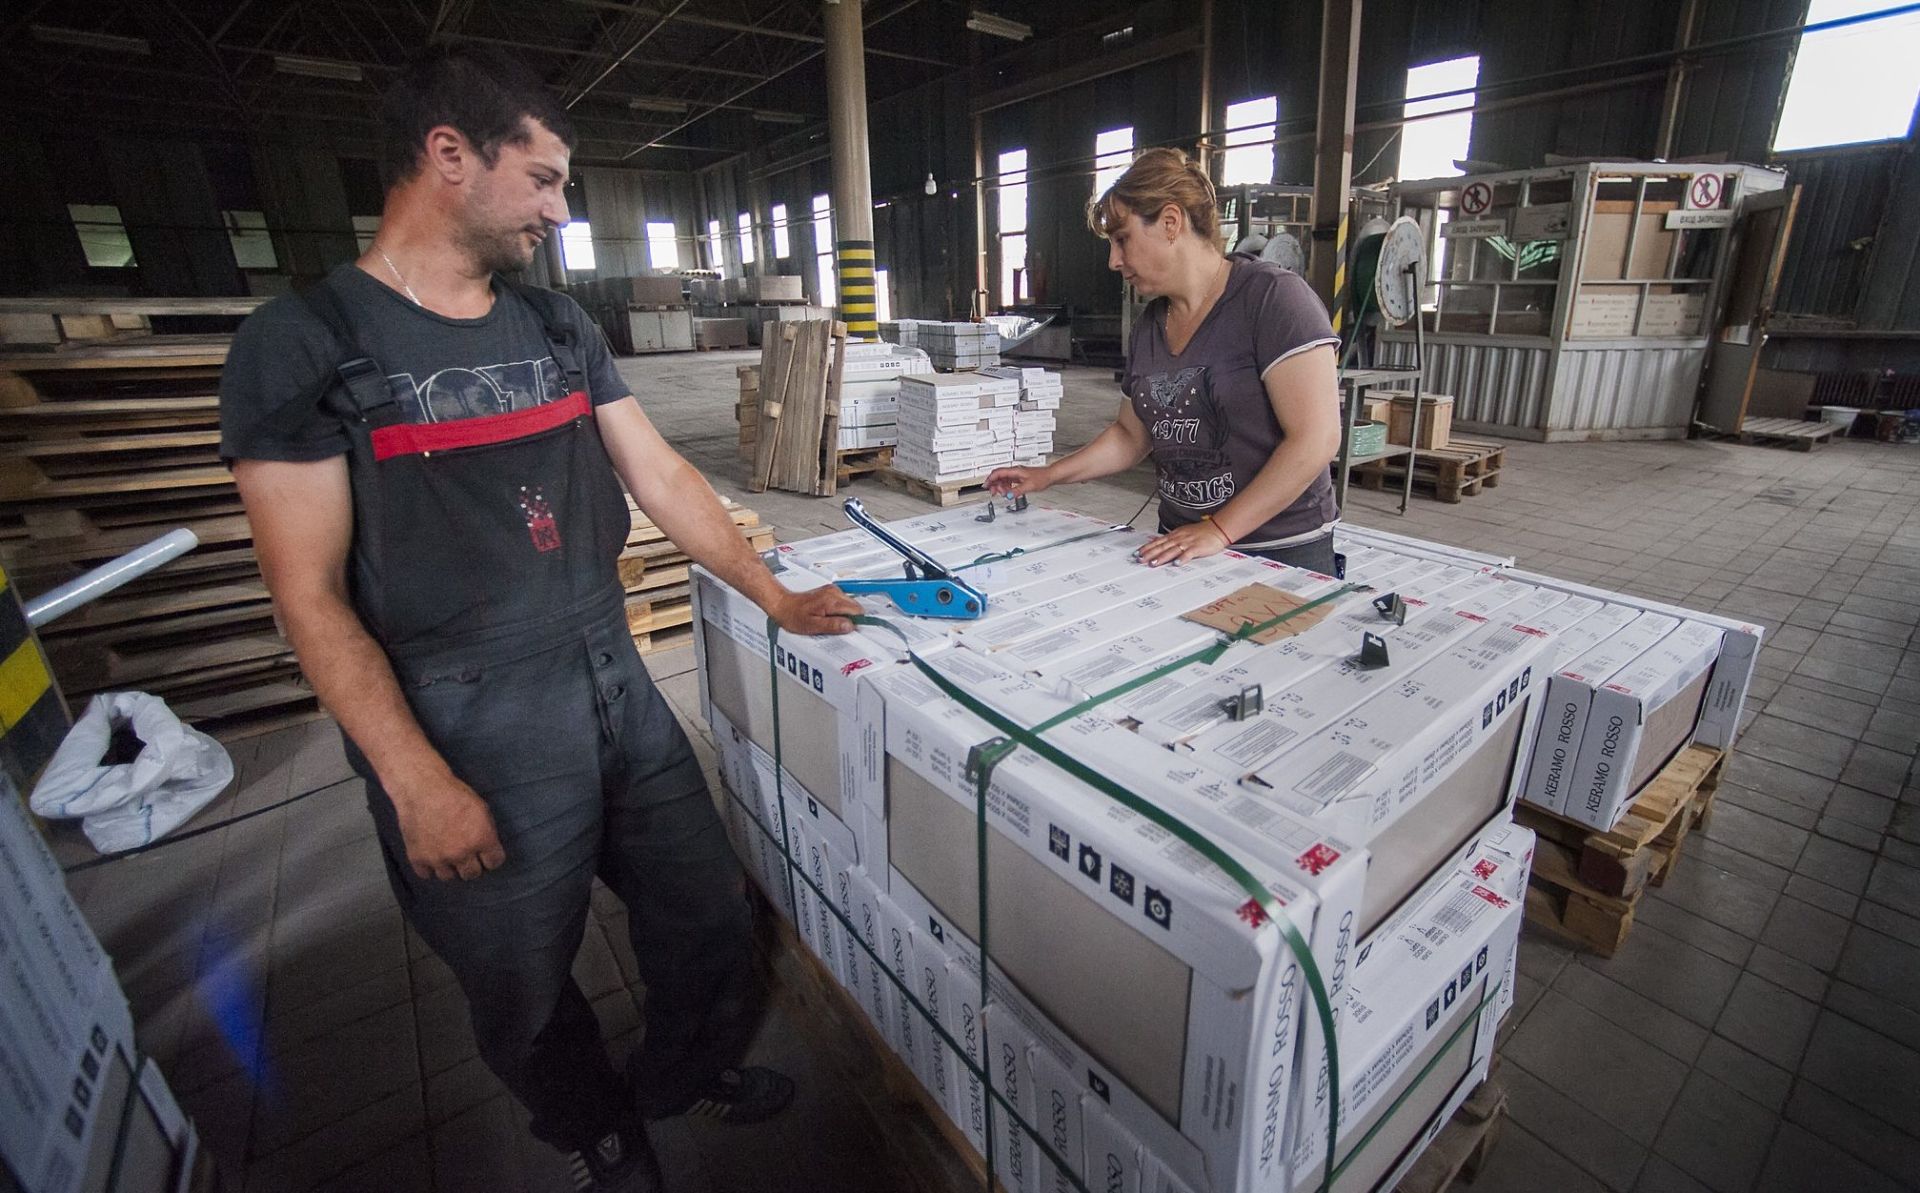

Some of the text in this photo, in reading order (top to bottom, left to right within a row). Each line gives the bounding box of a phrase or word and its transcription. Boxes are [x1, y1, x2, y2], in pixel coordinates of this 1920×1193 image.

[1152, 418, 1200, 443] 1977
[1544, 702, 1578, 798] KERAMO ROSSO
[1587, 715, 1623, 813] KERAMO ROSSO
[1330, 910, 1353, 1001] ROSSO
[1259, 963, 1296, 1170] KERAMO ROSSO
[1052, 1089, 1068, 1157] ROSSO
